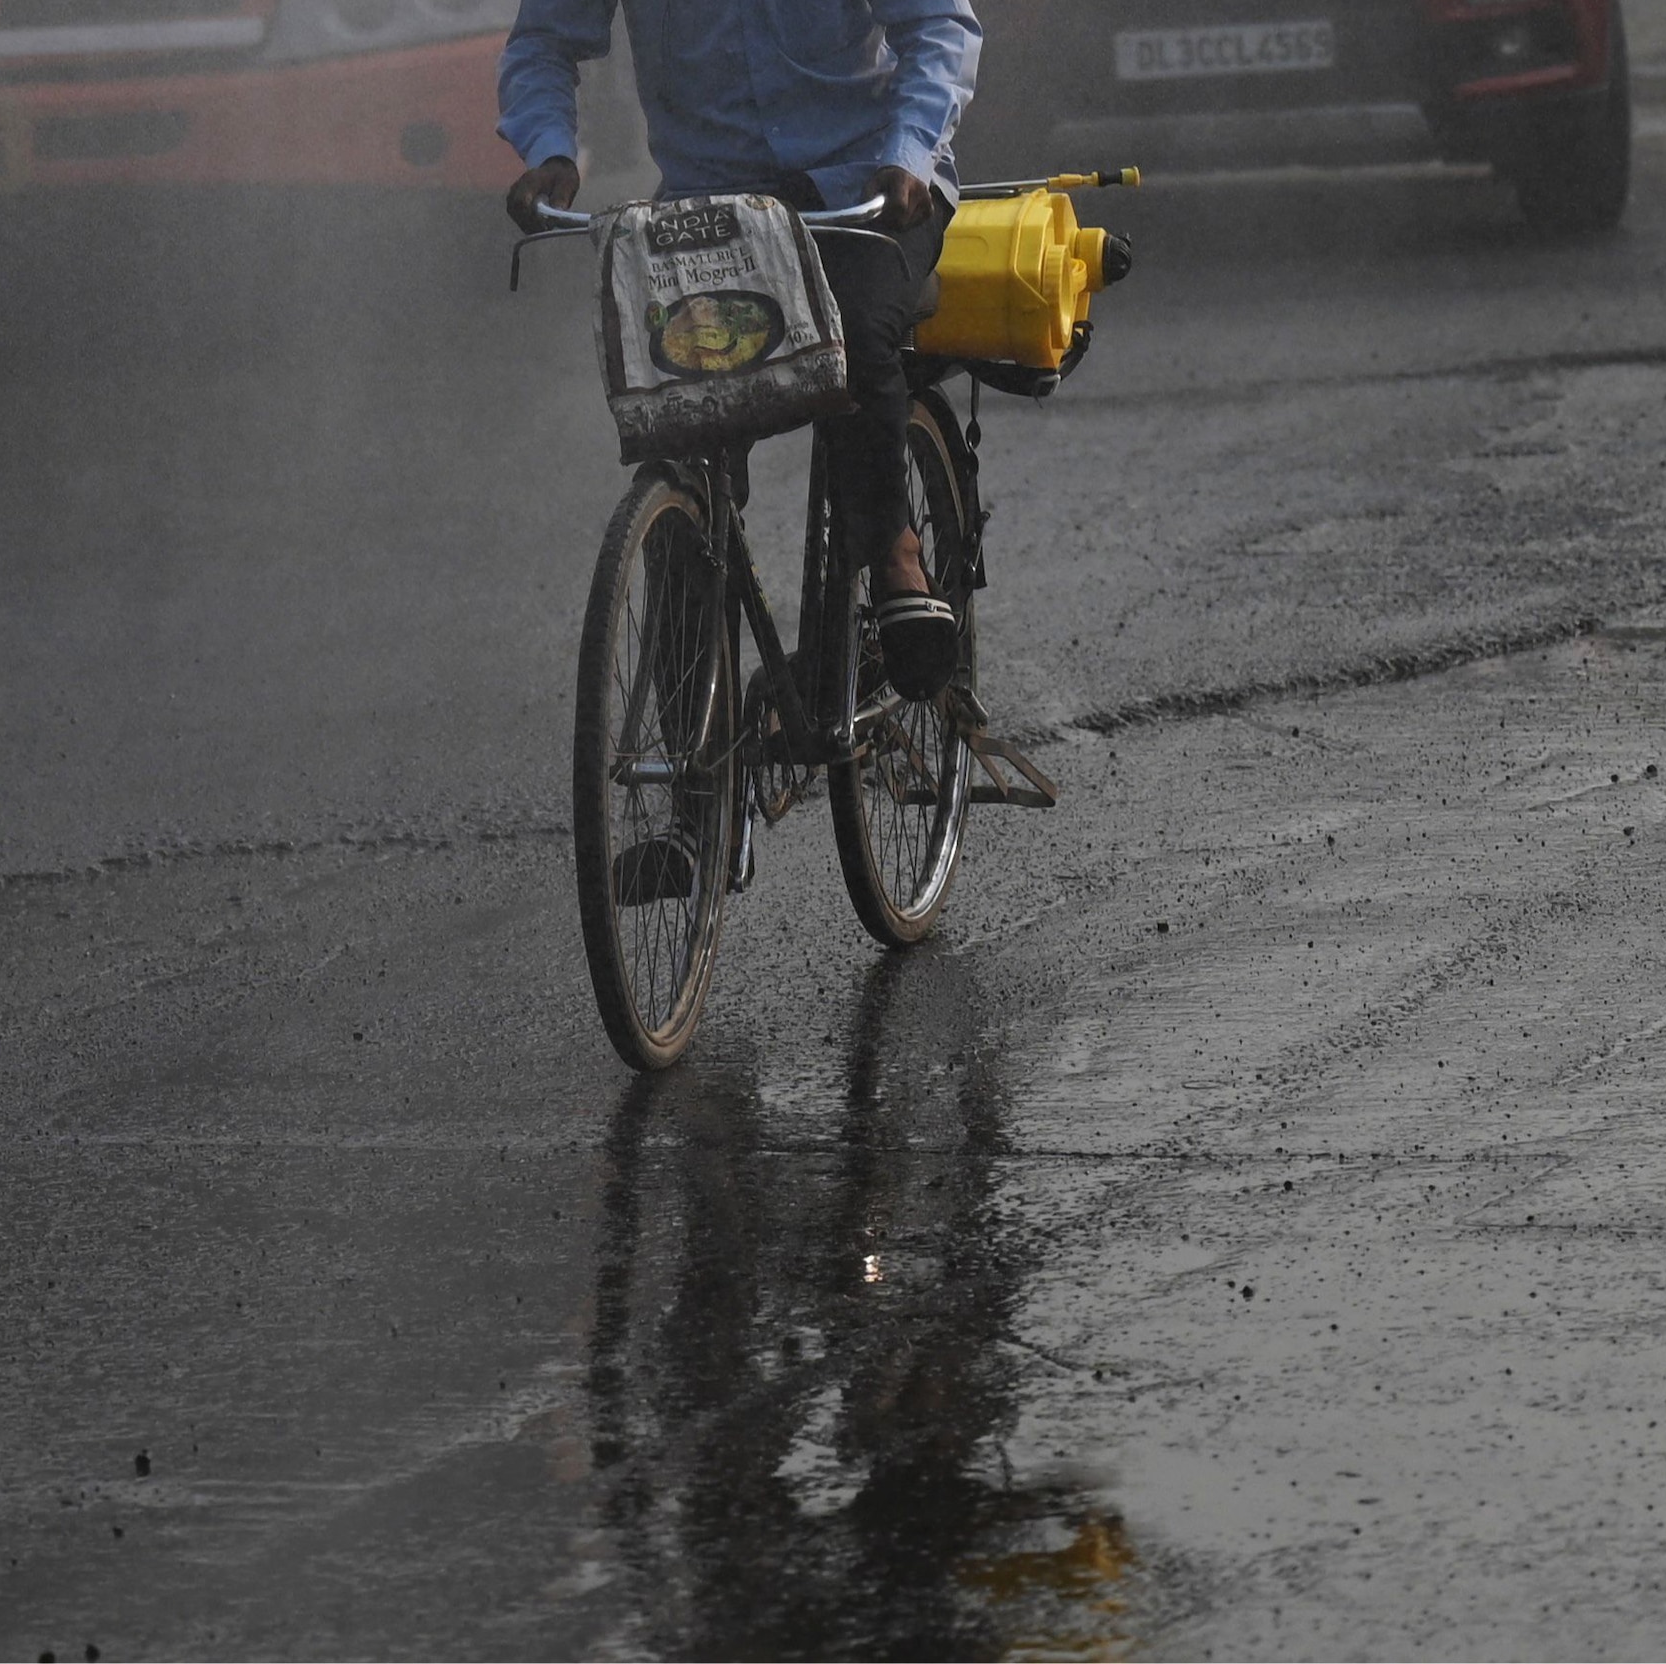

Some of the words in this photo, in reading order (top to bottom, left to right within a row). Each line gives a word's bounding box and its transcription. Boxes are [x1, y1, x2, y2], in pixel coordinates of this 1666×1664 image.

[652, 209, 730, 233] INDIA
[656, 225, 731, 246] GATE
[648, 270, 680, 293] Mini
[685, 255, 756, 286] Mogra-II
[652, 253, 713, 273] BASMATI
